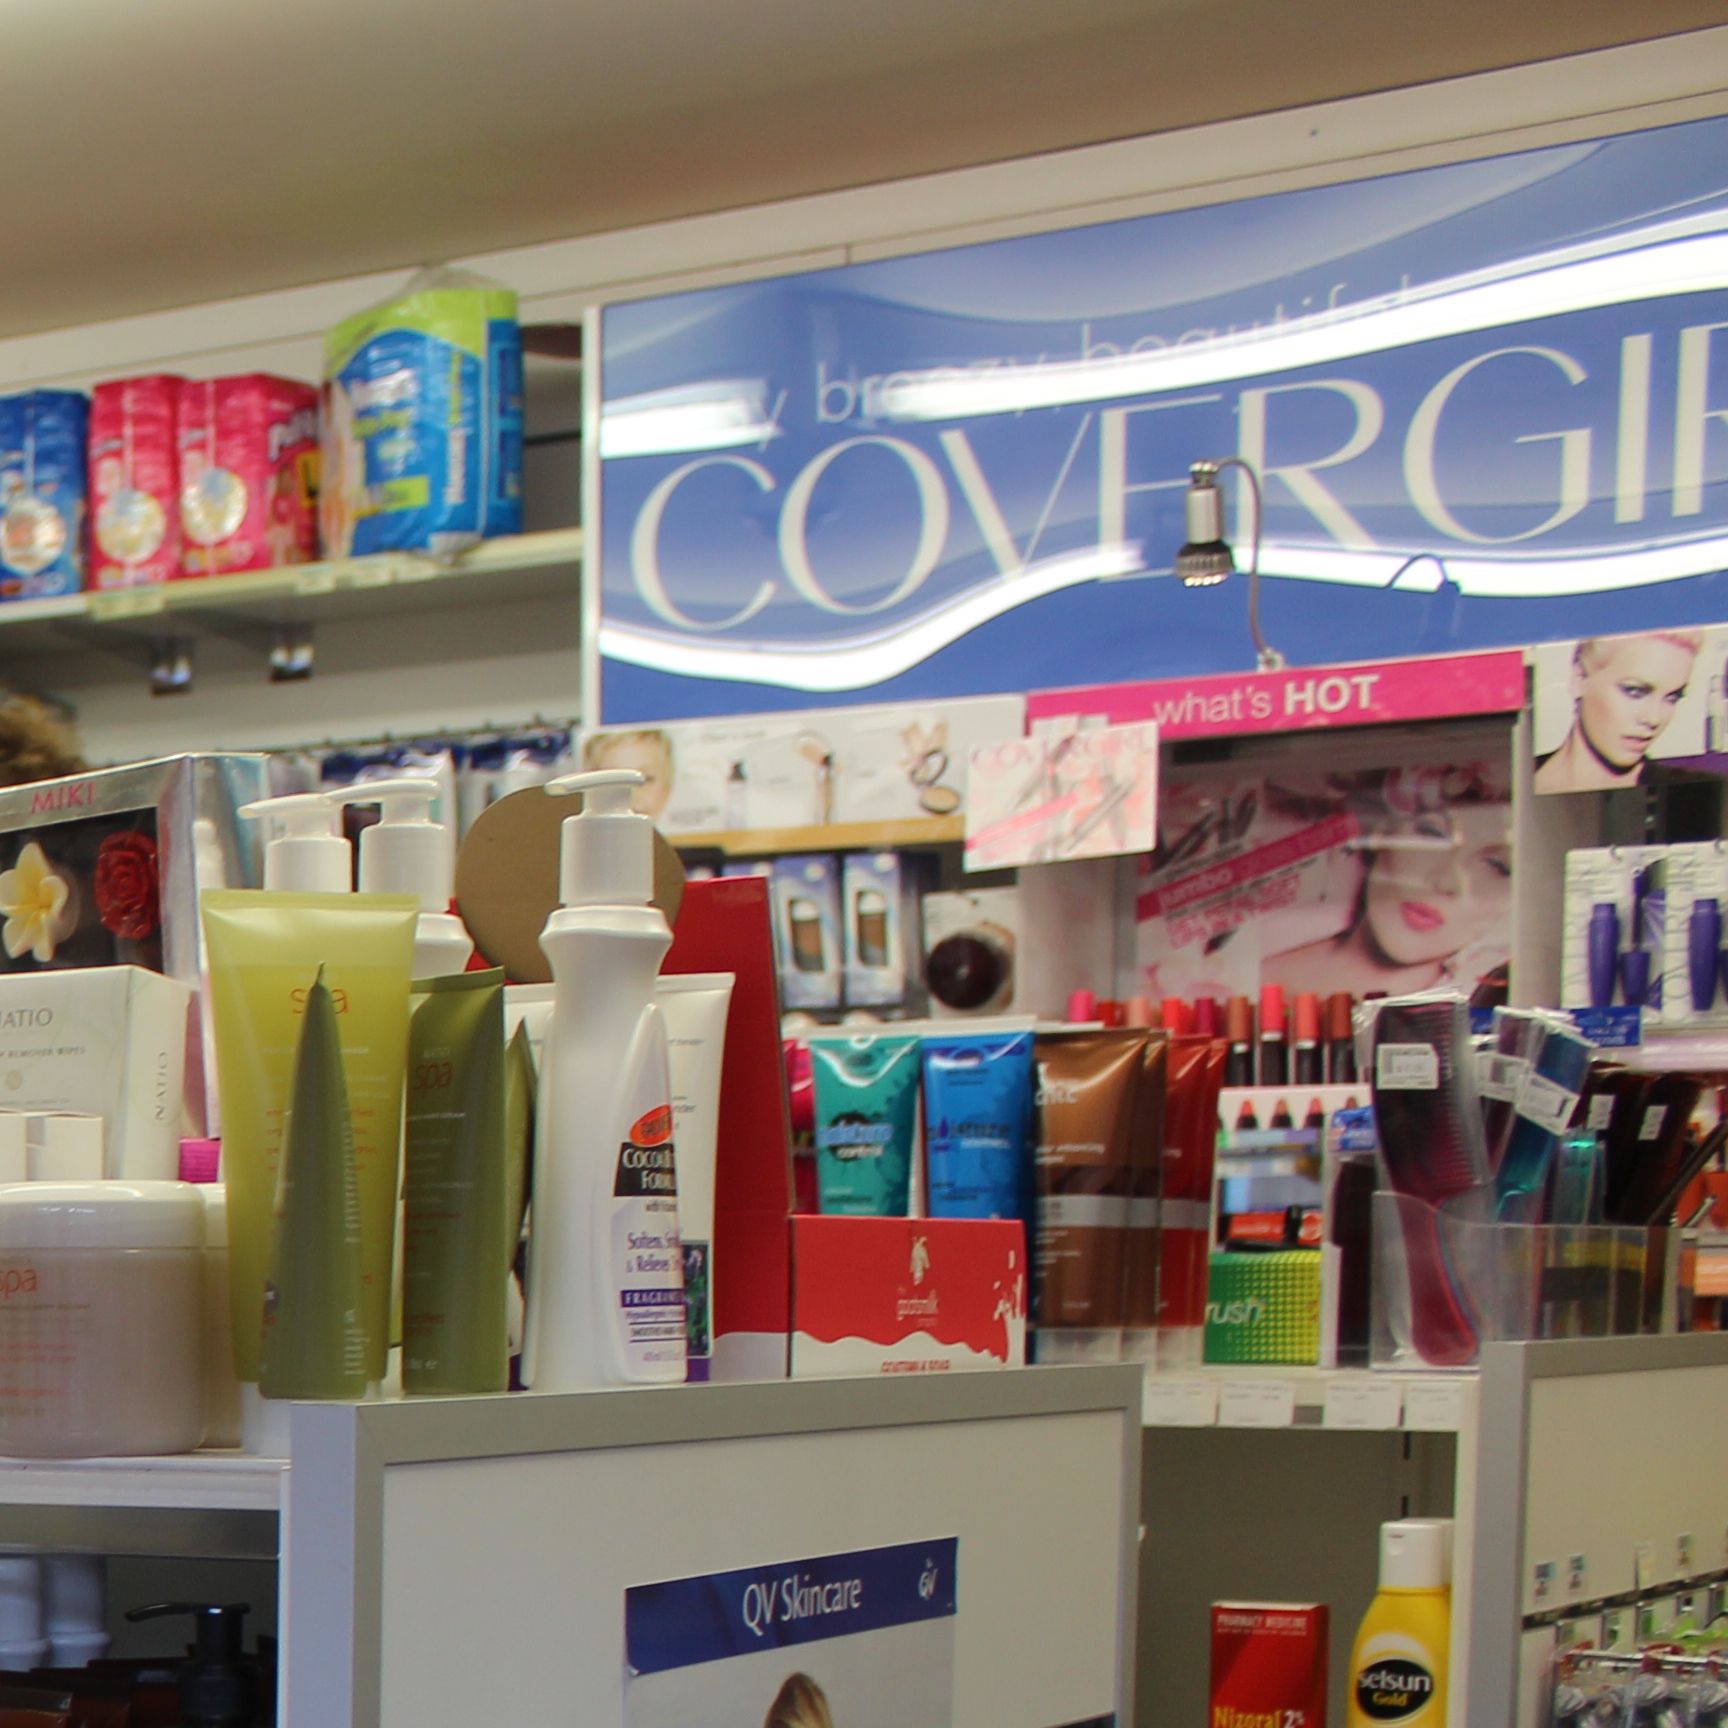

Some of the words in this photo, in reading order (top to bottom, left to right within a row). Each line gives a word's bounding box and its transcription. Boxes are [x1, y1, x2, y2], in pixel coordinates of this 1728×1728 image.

[1155, 685, 1273, 727] what's
[1284, 674, 1379, 714] HOT
[30, 779, 96, 814] MIKI
[743, 1580, 779, 1637] QV
[780, 1572, 864, 1624] Skincare
[1358, 1669, 1432, 1693] selsun
